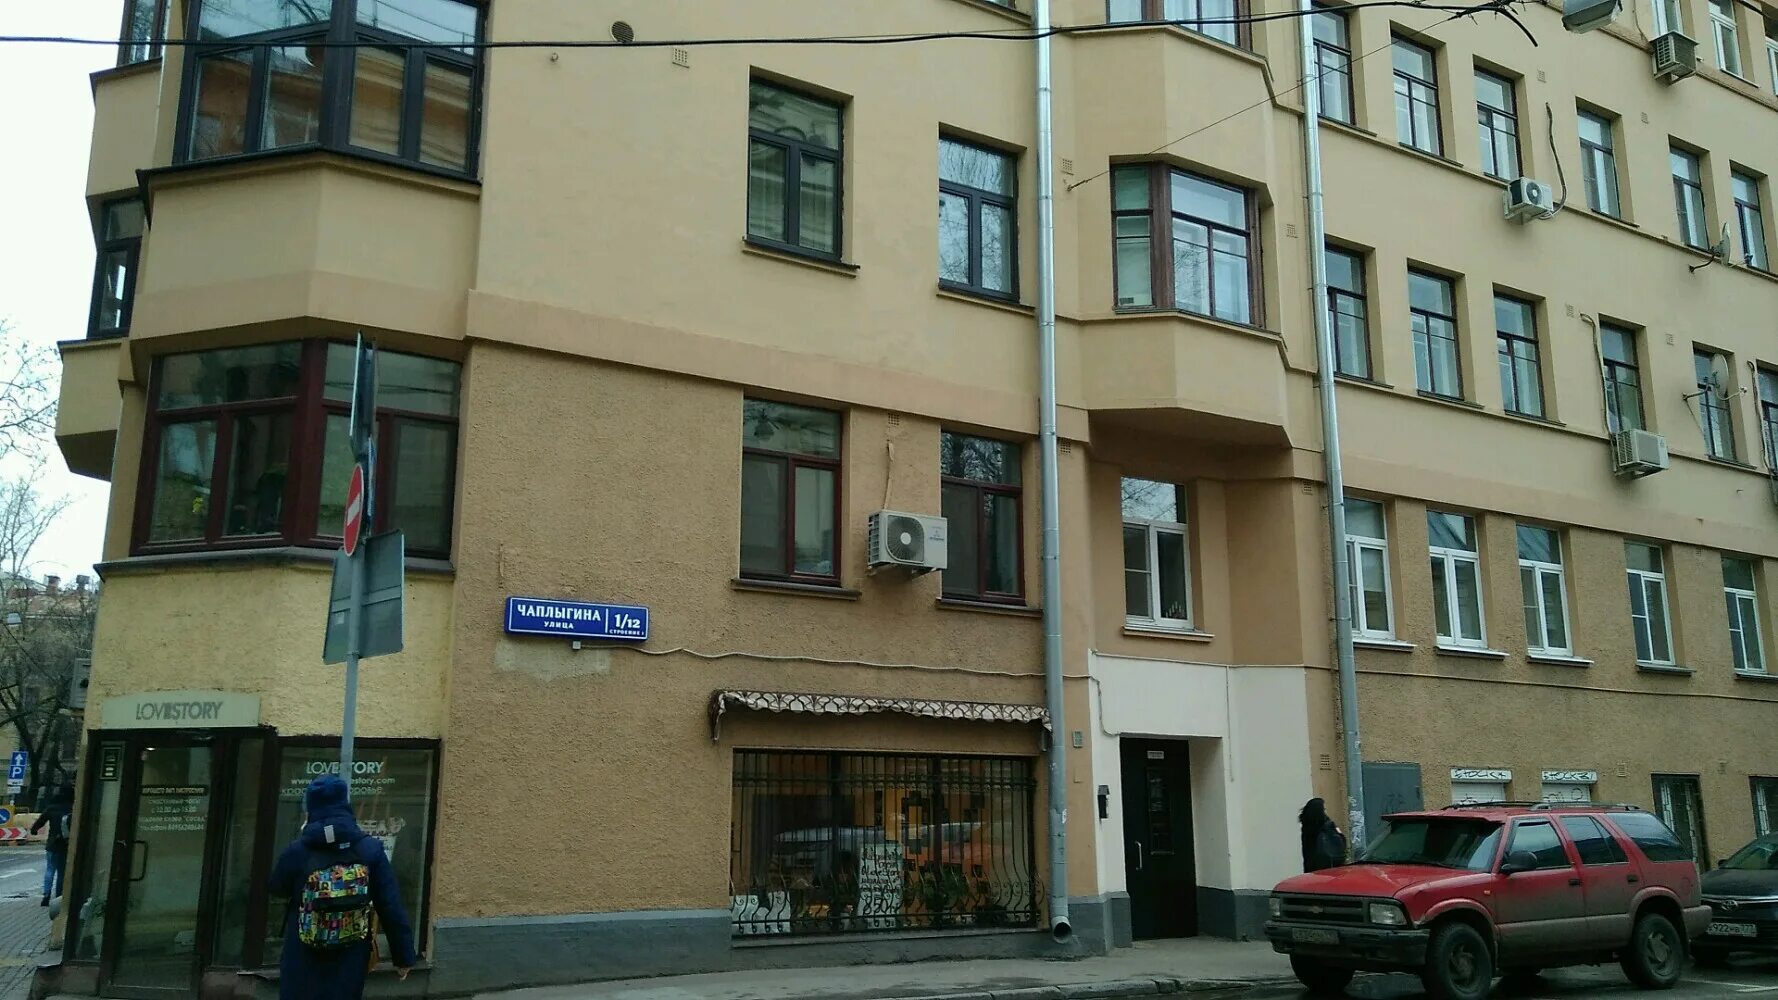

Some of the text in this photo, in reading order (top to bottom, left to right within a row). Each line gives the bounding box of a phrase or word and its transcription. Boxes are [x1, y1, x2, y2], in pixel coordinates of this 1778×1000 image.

[517, 604, 601, 621] ЧАПЛЫГИНА
[544, 621, 574, 629] УЛИЦА
[615, 613, 641, 629] 1/12
